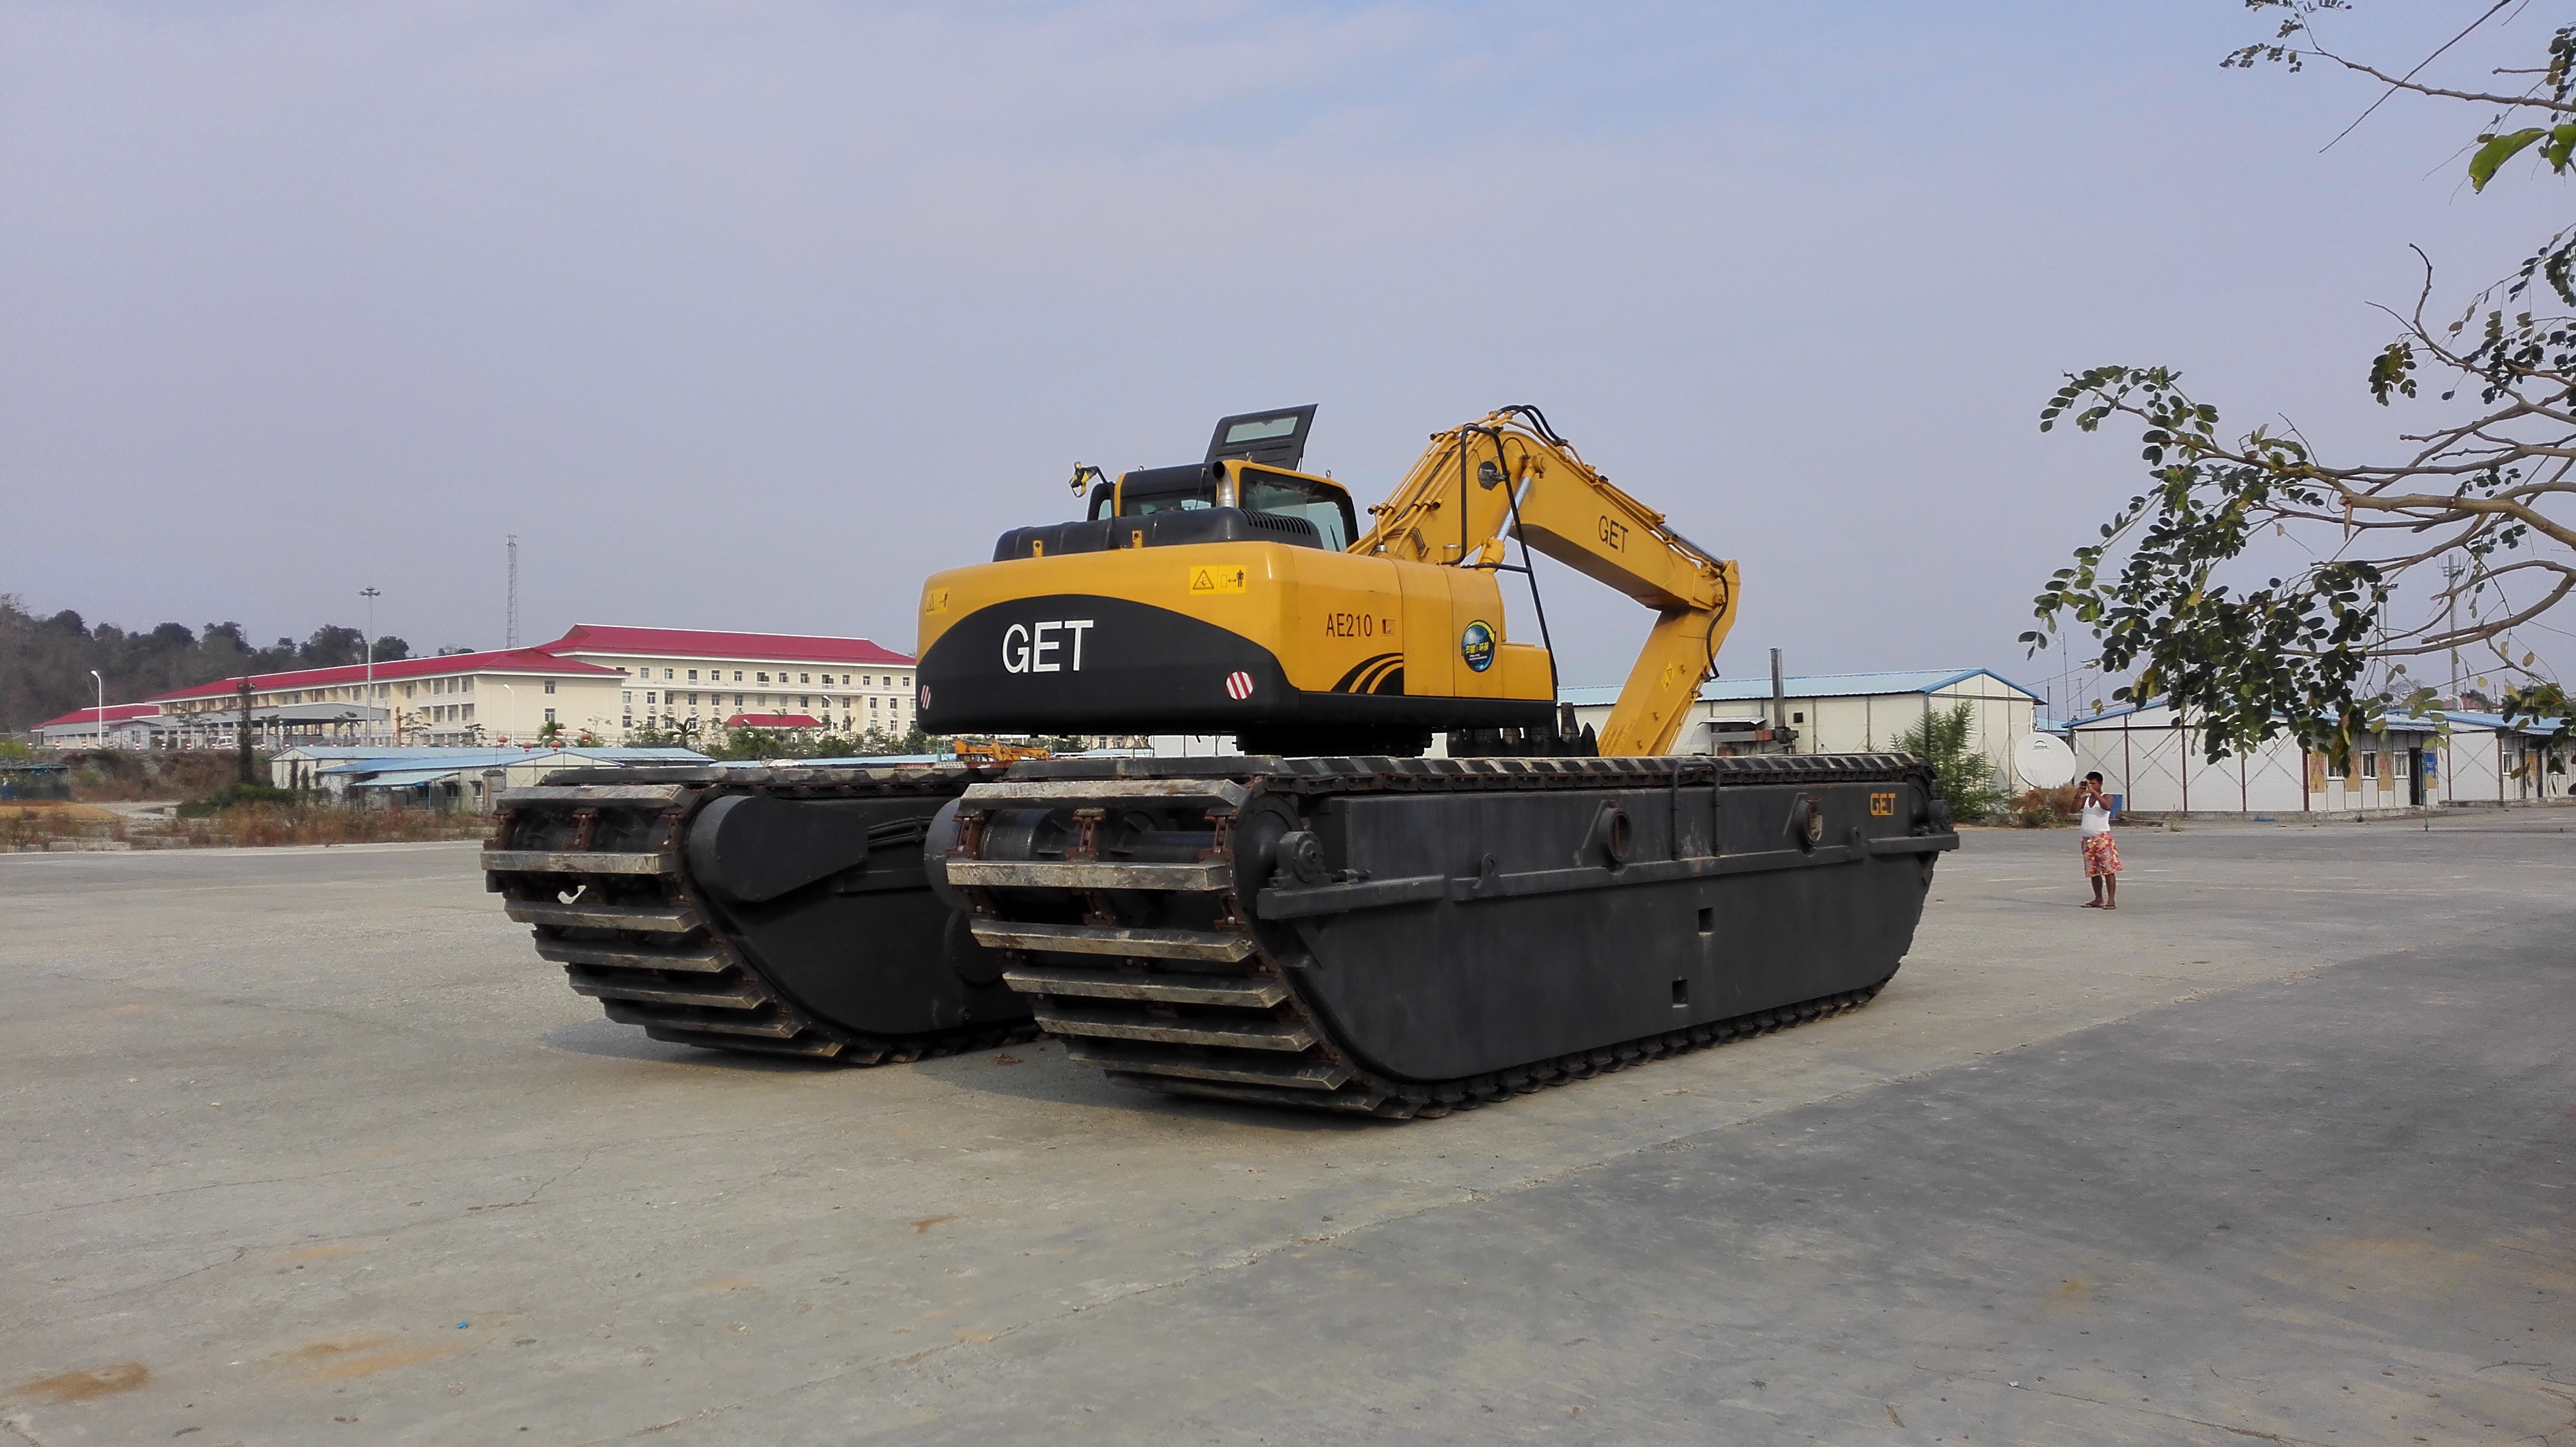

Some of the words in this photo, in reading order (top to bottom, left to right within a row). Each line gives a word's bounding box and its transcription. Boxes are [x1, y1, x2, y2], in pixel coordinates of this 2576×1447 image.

[1599, 515, 1629, 554] GET
[1326, 613, 1372, 637] AE210
[1003, 619, 1094, 673] GET
[1870, 793, 1896, 816] GET
